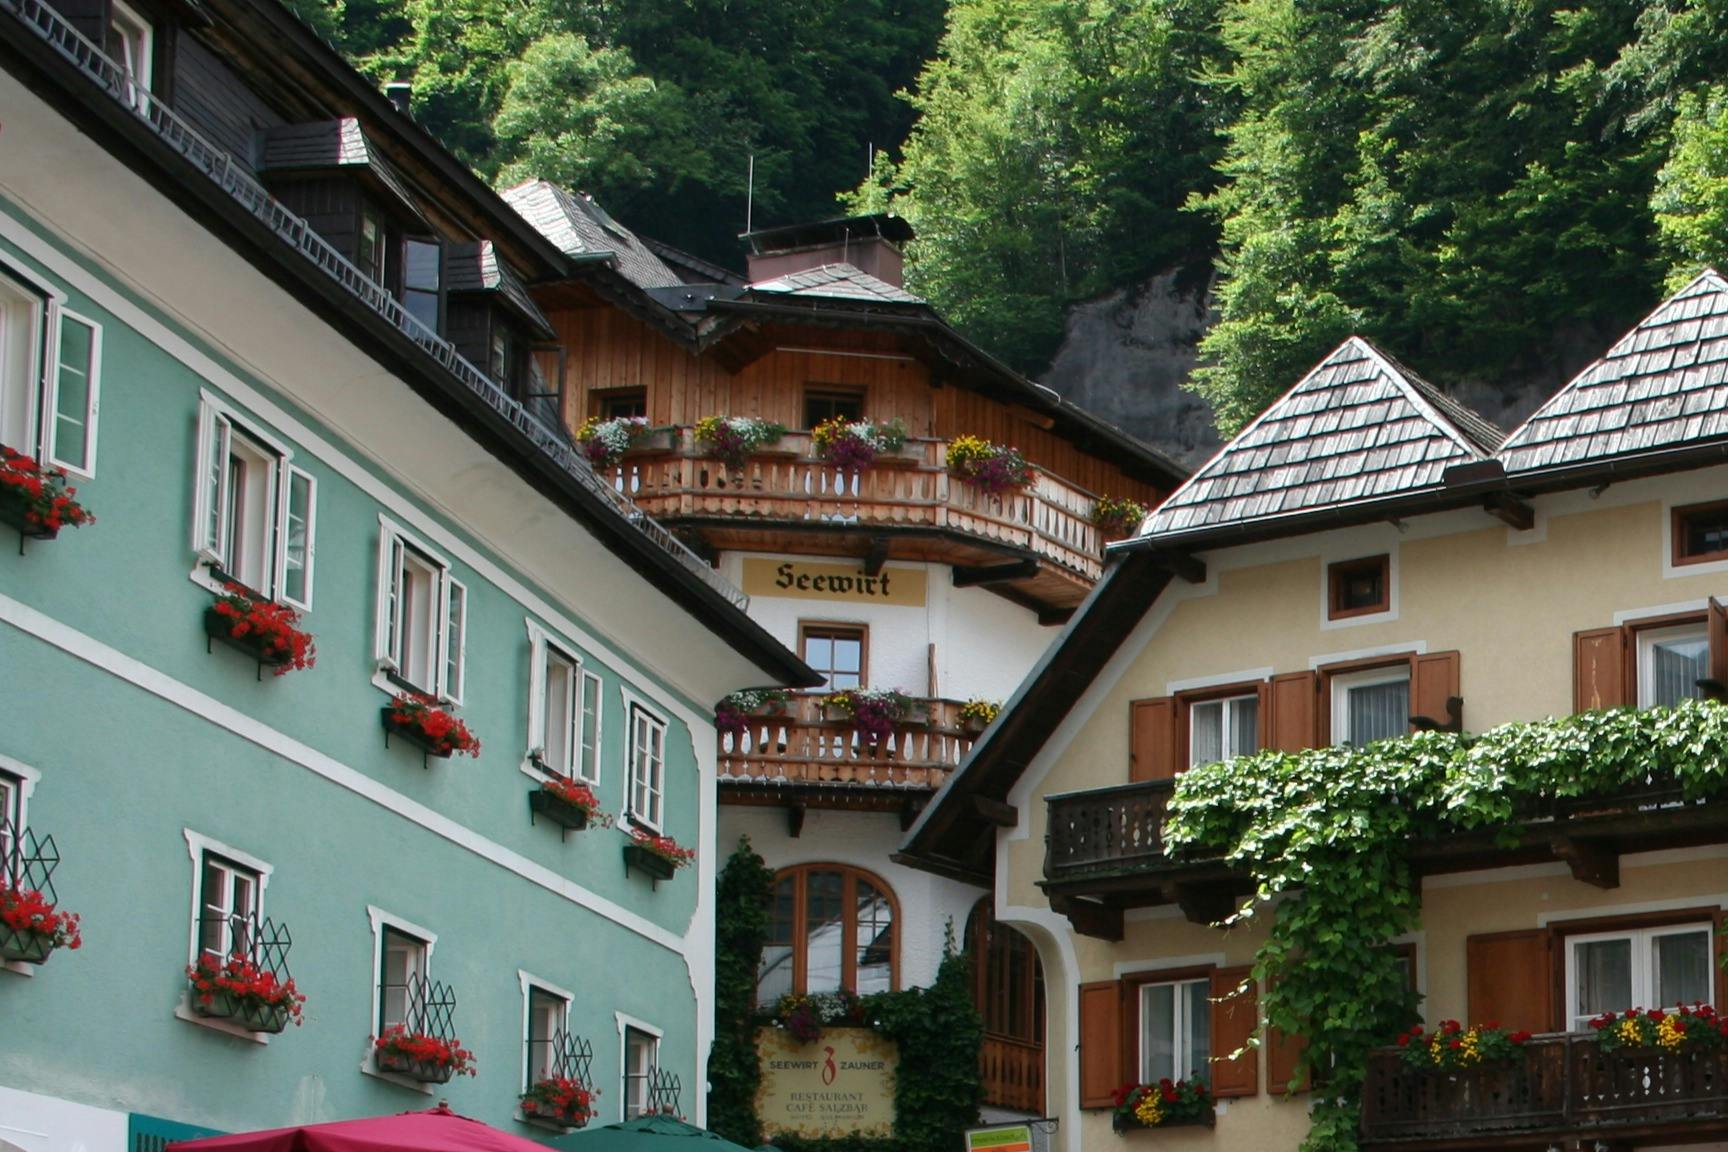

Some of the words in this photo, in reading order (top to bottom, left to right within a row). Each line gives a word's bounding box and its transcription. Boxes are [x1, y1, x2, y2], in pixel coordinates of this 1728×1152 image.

[775, 563, 891, 597] Seewirt
[769, 1060, 818, 1071] SEEWIRT
[839, 1061, 886, 1071] ZAUNER
[790, 1092, 864, 1102] RESTAURANT
[819, 1103, 869, 1113] SALZBAR
